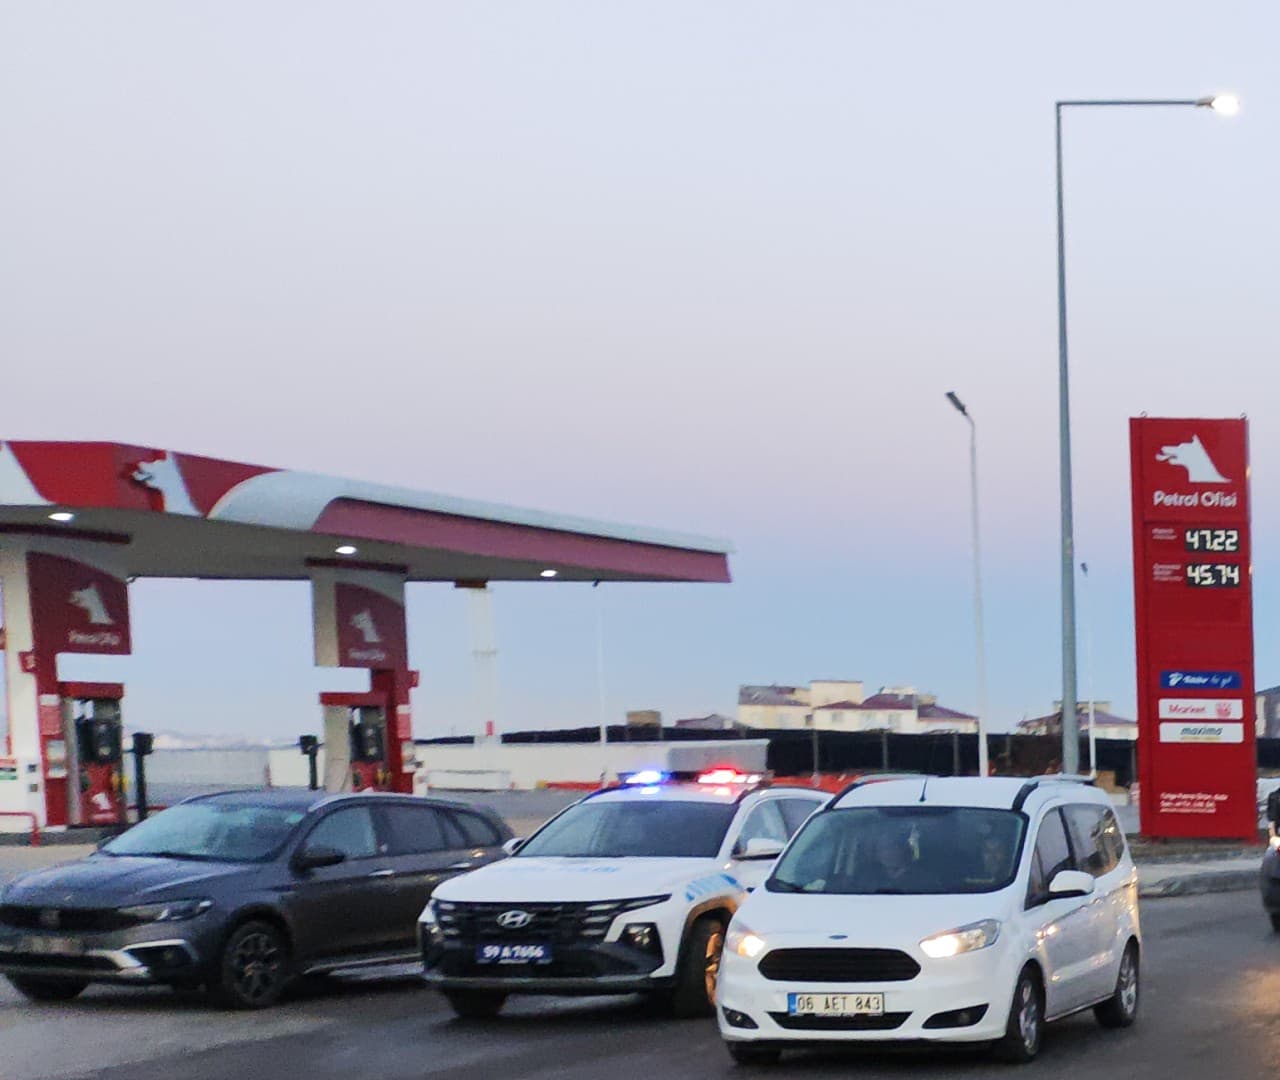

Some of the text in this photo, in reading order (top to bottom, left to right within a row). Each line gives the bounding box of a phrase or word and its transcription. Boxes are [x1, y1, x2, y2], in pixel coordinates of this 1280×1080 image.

[1153, 490, 1237, 507] Petrol Ofisi
[798, 996, 815, 1011] 06
